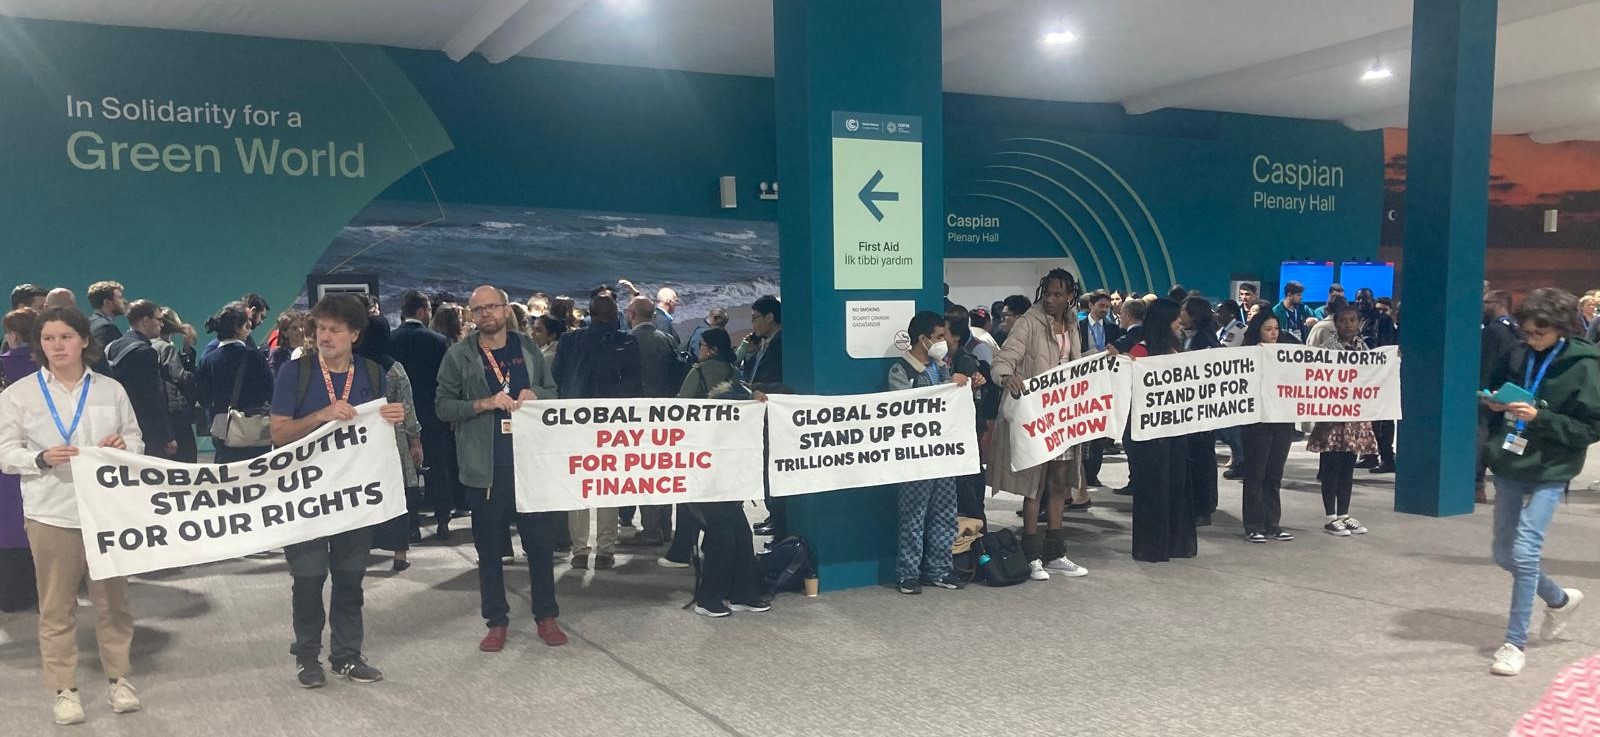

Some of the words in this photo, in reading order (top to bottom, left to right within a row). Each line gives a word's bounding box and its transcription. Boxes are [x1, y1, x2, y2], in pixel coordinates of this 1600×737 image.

[66, 95, 93, 118] In
[102, 97, 236, 129] Solidarity
[244, 104, 280, 127] for
[287, 111, 302, 128] a
[66, 130, 221, 173] Green
[234, 137, 366, 178] World
[1252, 155, 1343, 191] Caspian
[1254, 191, 1306, 214] Plenary
[1309, 194, 1335, 211] Hall
[947, 213, 1000, 230] Caspian
[858, 241, 881, 252] First
[883, 242, 900, 252] Aid
[948, 232, 981, 244] Plenary
[982, 233, 999, 242] Hall
[1277, 349, 1333, 364] GLOBAL
[1336, 351, 1387, 365] NORTH:
[1143, 365, 1200, 387] GLOBAL
[1204, 358, 1255, 378] SOUTH:
[1305, 368, 1335, 382] PAY
[1337, 369, 1358, 383] UP
[1042, 386, 1069, 408] PAY
[1070, 380, 1089, 399] UP
[1145, 387, 1195, 408] STAND
[1198, 383, 1216, 400] UP
[1220, 378, 1249, 397] FOR
[1276, 385, 1349, 400] TRILLIONS
[1352, 386, 1380, 400] NOT
[541, 406, 642, 426] GLOBAL
[649, 404, 740, 423] NORTH:
[792, 404, 871, 427] GLOBAL
[876, 398, 946, 419] SOUTH:
[1140, 407, 1194, 430] PUBLIC
[1197, 397, 1255, 421] FINANCE
[1296, 402, 1361, 417] BILLIONS
[596, 429, 645, 448] PAY
[651, 428, 686, 447] UP
[799, 429, 864, 450] STAND
[869, 426, 895, 443] UP
[901, 421, 942, 439] FOR
[1023, 412, 1055, 438] YOUR
[1067, 416, 1107, 439] NOW
[96, 464, 239, 488] GLOBAL
[248, 424, 368, 477] SOUTH:
[569, 454, 617, 474] FOR
[624, 451, 712, 471] PUBLIC
[775, 452, 854, 472] TRILLIONS
[858, 449, 890, 464] NOT
[895, 442, 965, 461] BILLIONS
[150, 483, 267, 515] STAND
[277, 465, 323, 493] UP
[582, 476, 687, 499] FINANCE
[97, 524, 168, 554] FOR
[178, 512, 253, 541] OUR
[261, 481, 384, 527] RIGHTS
